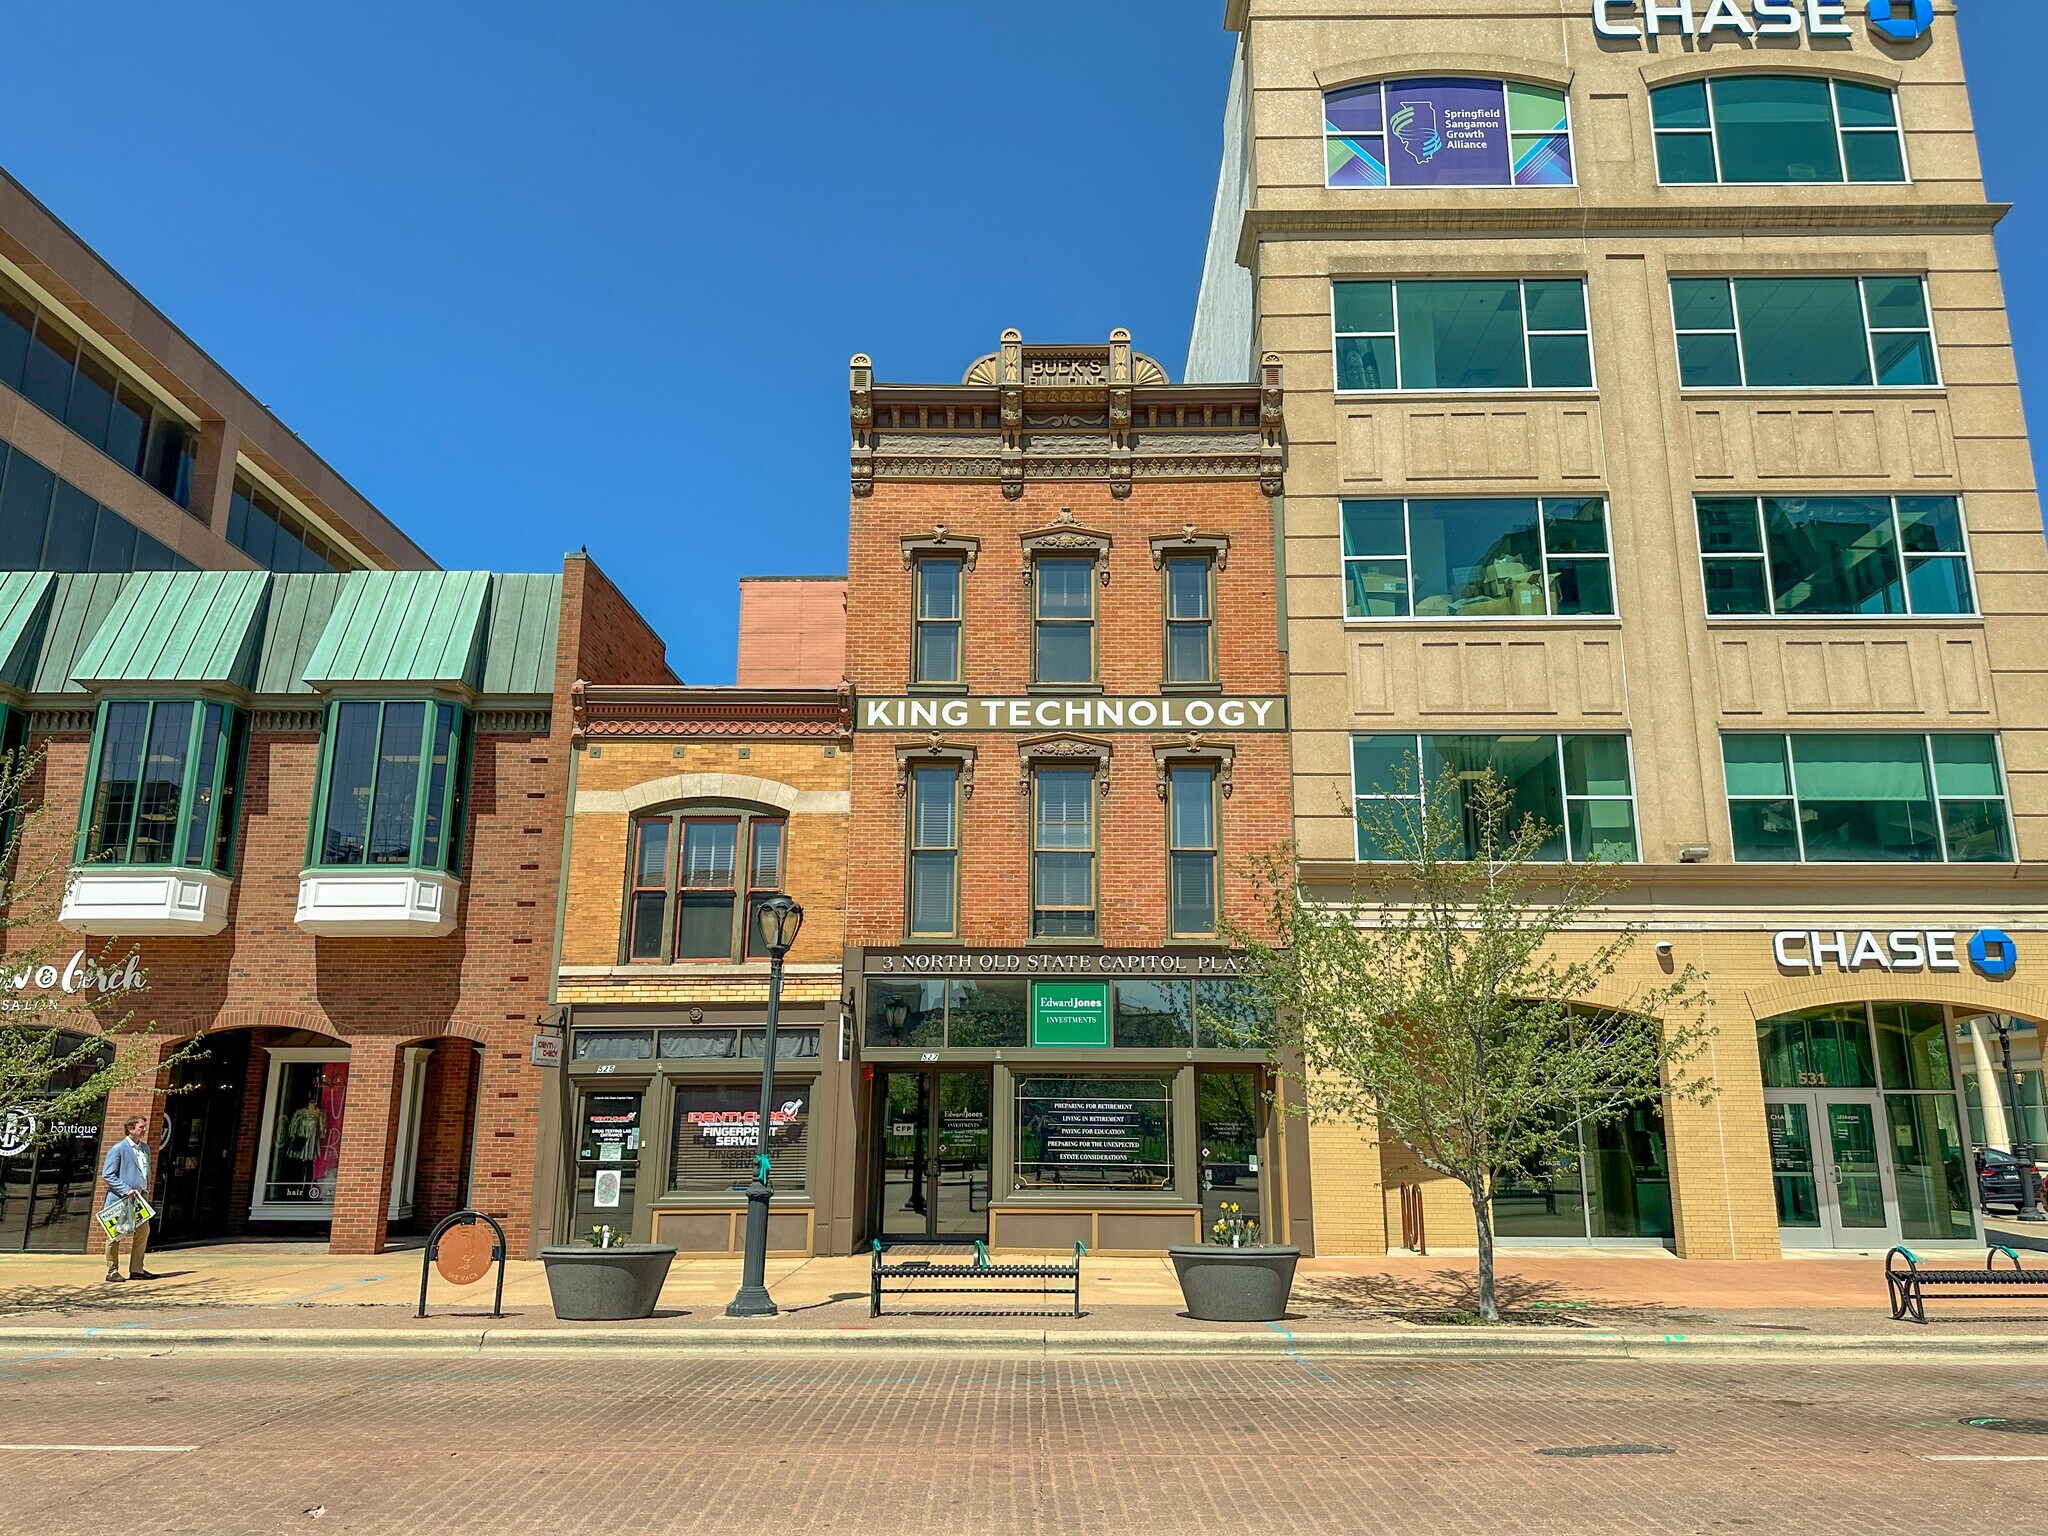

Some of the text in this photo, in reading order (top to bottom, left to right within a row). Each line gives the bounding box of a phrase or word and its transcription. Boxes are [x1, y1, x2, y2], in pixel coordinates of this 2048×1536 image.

[1593, 0, 1854, 38] CHASE
[1444, 109, 1501, 120] Springfield
[1445, 120, 1499, 130] Sangamon
[1446, 130, 1485, 139] Growth
[1447, 140, 1488, 149] Alliance
[1031, 361, 1102, 375] BUCK'S
[866, 701, 1274, 726] KING TECHNOLOGY
[1774, 931, 1961, 968] CHASE
[883, 955, 1265, 970] 3 NORTH OLD STATE CAPITOL PLAZ
[1, 1000, 58, 1010] SALON
[1046, 1016, 1097, 1024] INVESTMENTS
[597, 1065, 615, 1073] 525
[1798, 1072, 1826, 1085] 531
[50, 1121, 98, 1136] boutique
[286, 1188, 304, 1196] hair
[460, 1273, 479, 1281] RACK
